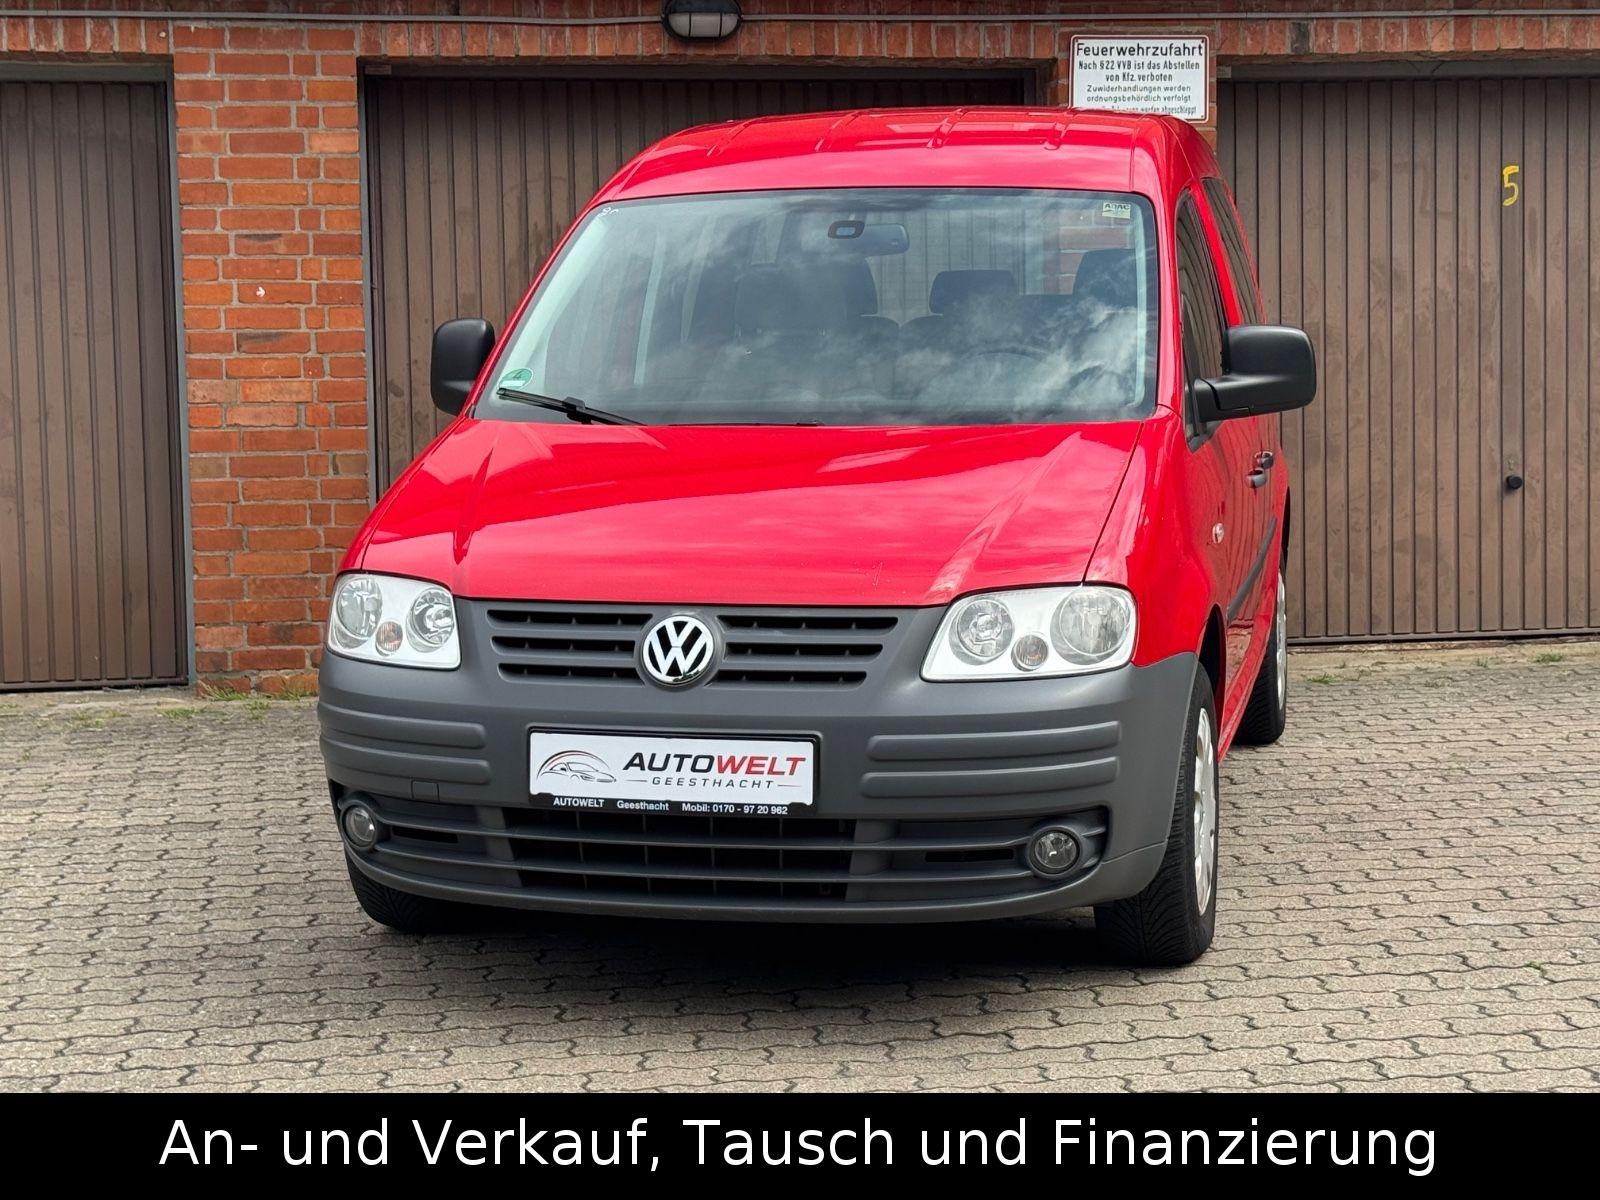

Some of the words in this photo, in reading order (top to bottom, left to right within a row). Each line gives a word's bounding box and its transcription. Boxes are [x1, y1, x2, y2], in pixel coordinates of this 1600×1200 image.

[1076, 43, 1203, 56] Feuerwehrzufahrt
[1078, 60, 1098, 70] Nach
[1134, 60, 1145, 70] ist
[1146, 60, 1161, 70] das
[1163, 60, 1200, 70] Abstellen
[1138, 72, 1173, 81] verboten
[1086, 85, 1162, 93] Zuwiderhandlungen
[1086, 95, 1162, 103] ordnungsbehördlich
[1163, 95, 1191, 103] verfolgt
[1503, 165, 1519, 206] 5
[622, 752, 806, 776] AUTOWELT
[652, 776, 775, 789] GEESTHACHT
[553, 797, 605, 808] AUTOWELT
[617, 800, 669, 811] Geesthacht
[682, 802, 711, 813] Mobil:
[712, 804, 735, 813] 0170
[743, 805, 755, 814] 97
[757, 806, 769, 814] 20
[771, 806, 788, 815] 962
